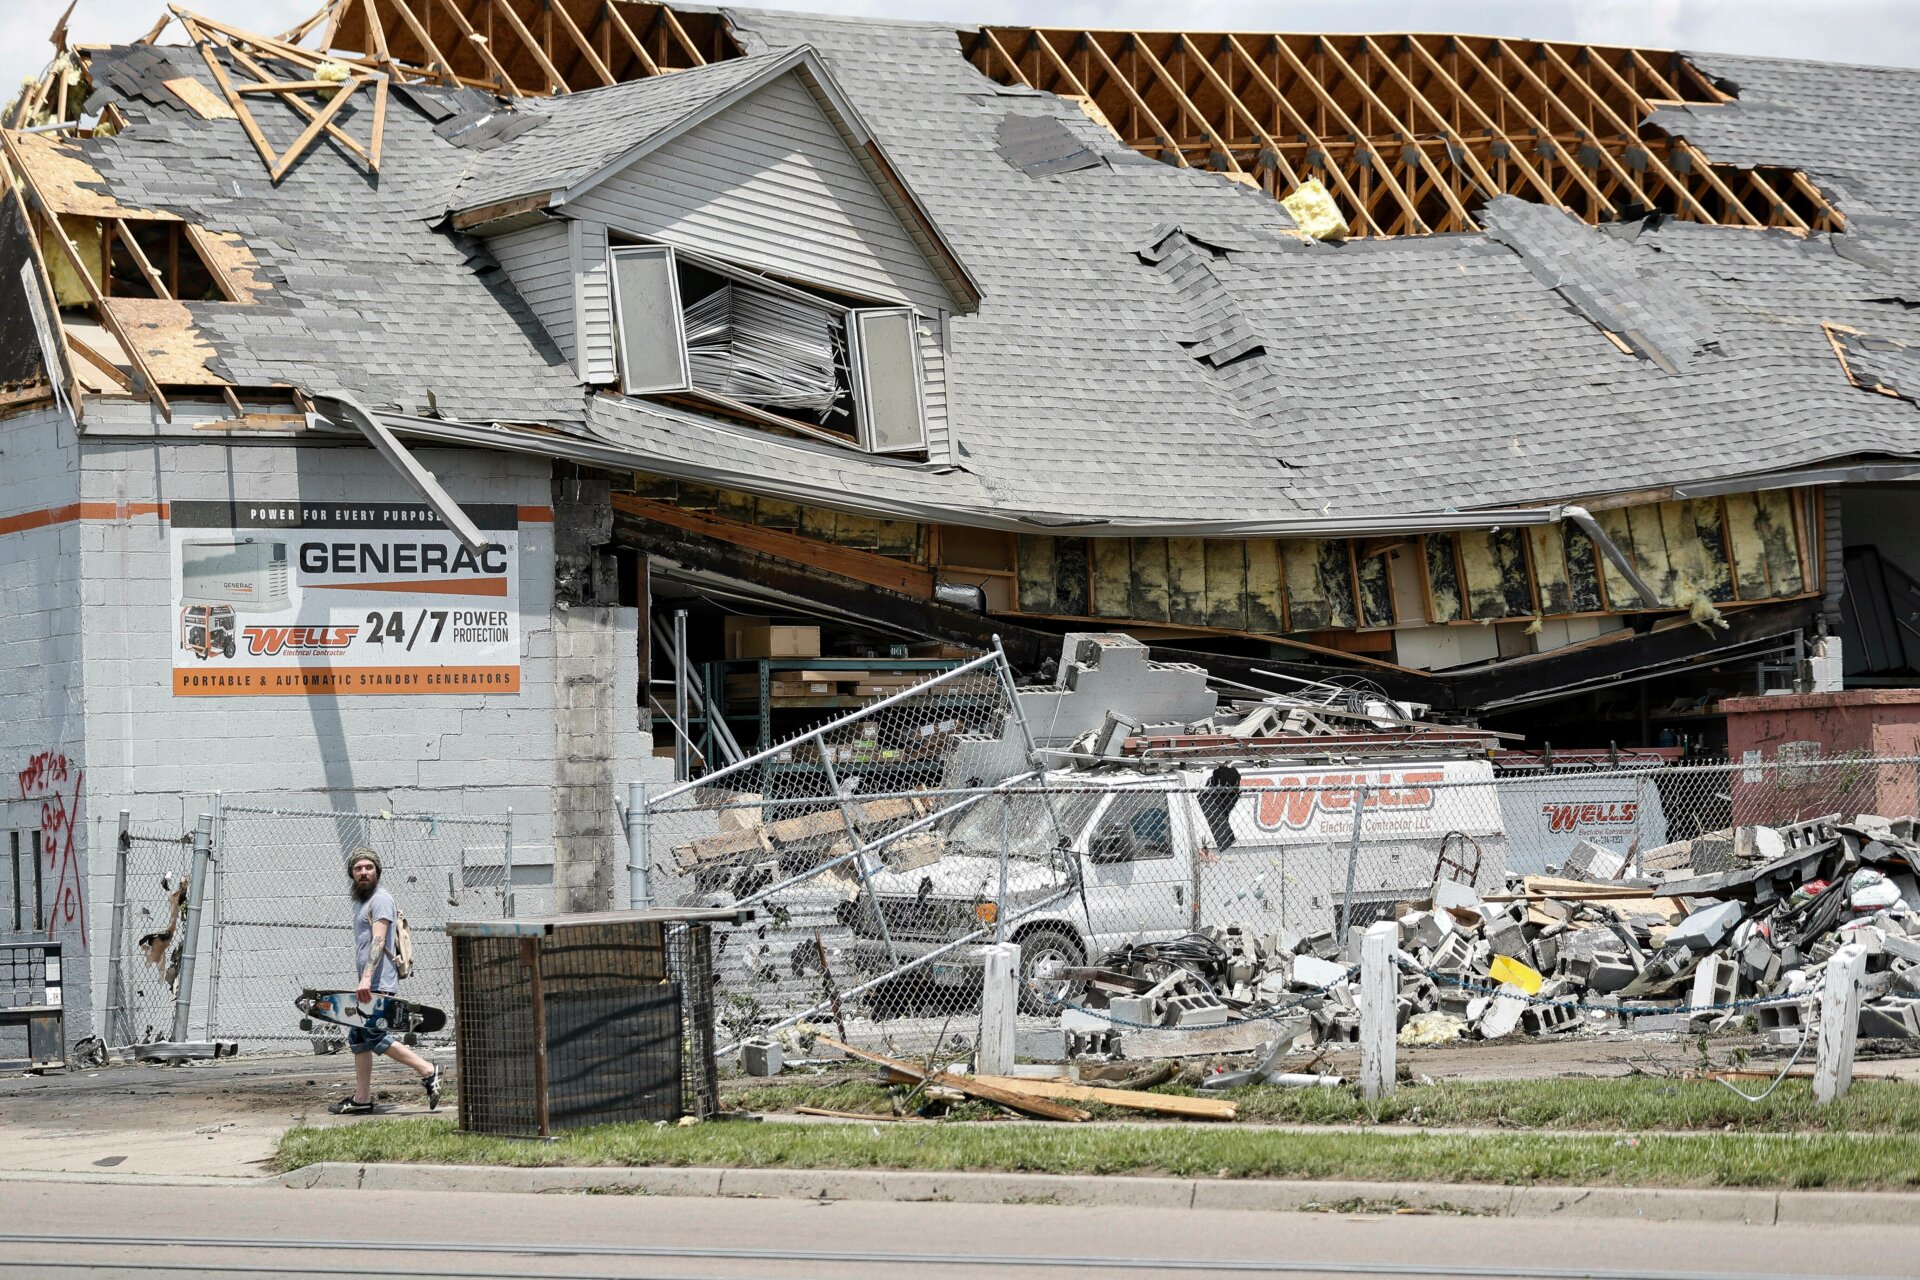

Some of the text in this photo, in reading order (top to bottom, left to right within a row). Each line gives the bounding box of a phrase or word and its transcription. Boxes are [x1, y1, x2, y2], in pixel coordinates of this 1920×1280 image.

[250, 508, 295, 520] POWER
[303, 509, 327, 521] FOR
[335, 510, 376, 521] EVERY
[299, 541, 507, 574] GENERAC
[243, 627, 359, 654] WELLS
[366, 608, 508, 652] 24/7 POWER
[453, 627, 509, 643] PROTECTION
[183, 673, 510, 686] PORTABLE & AUTOMATIC STANDBY GENERATORS
[1239, 772, 1444, 826] WELLS
[1365, 818, 1412, 832] Contractor
[1414, 816, 1432, 830] LLC
[1542, 803, 1638, 831] WELLS
